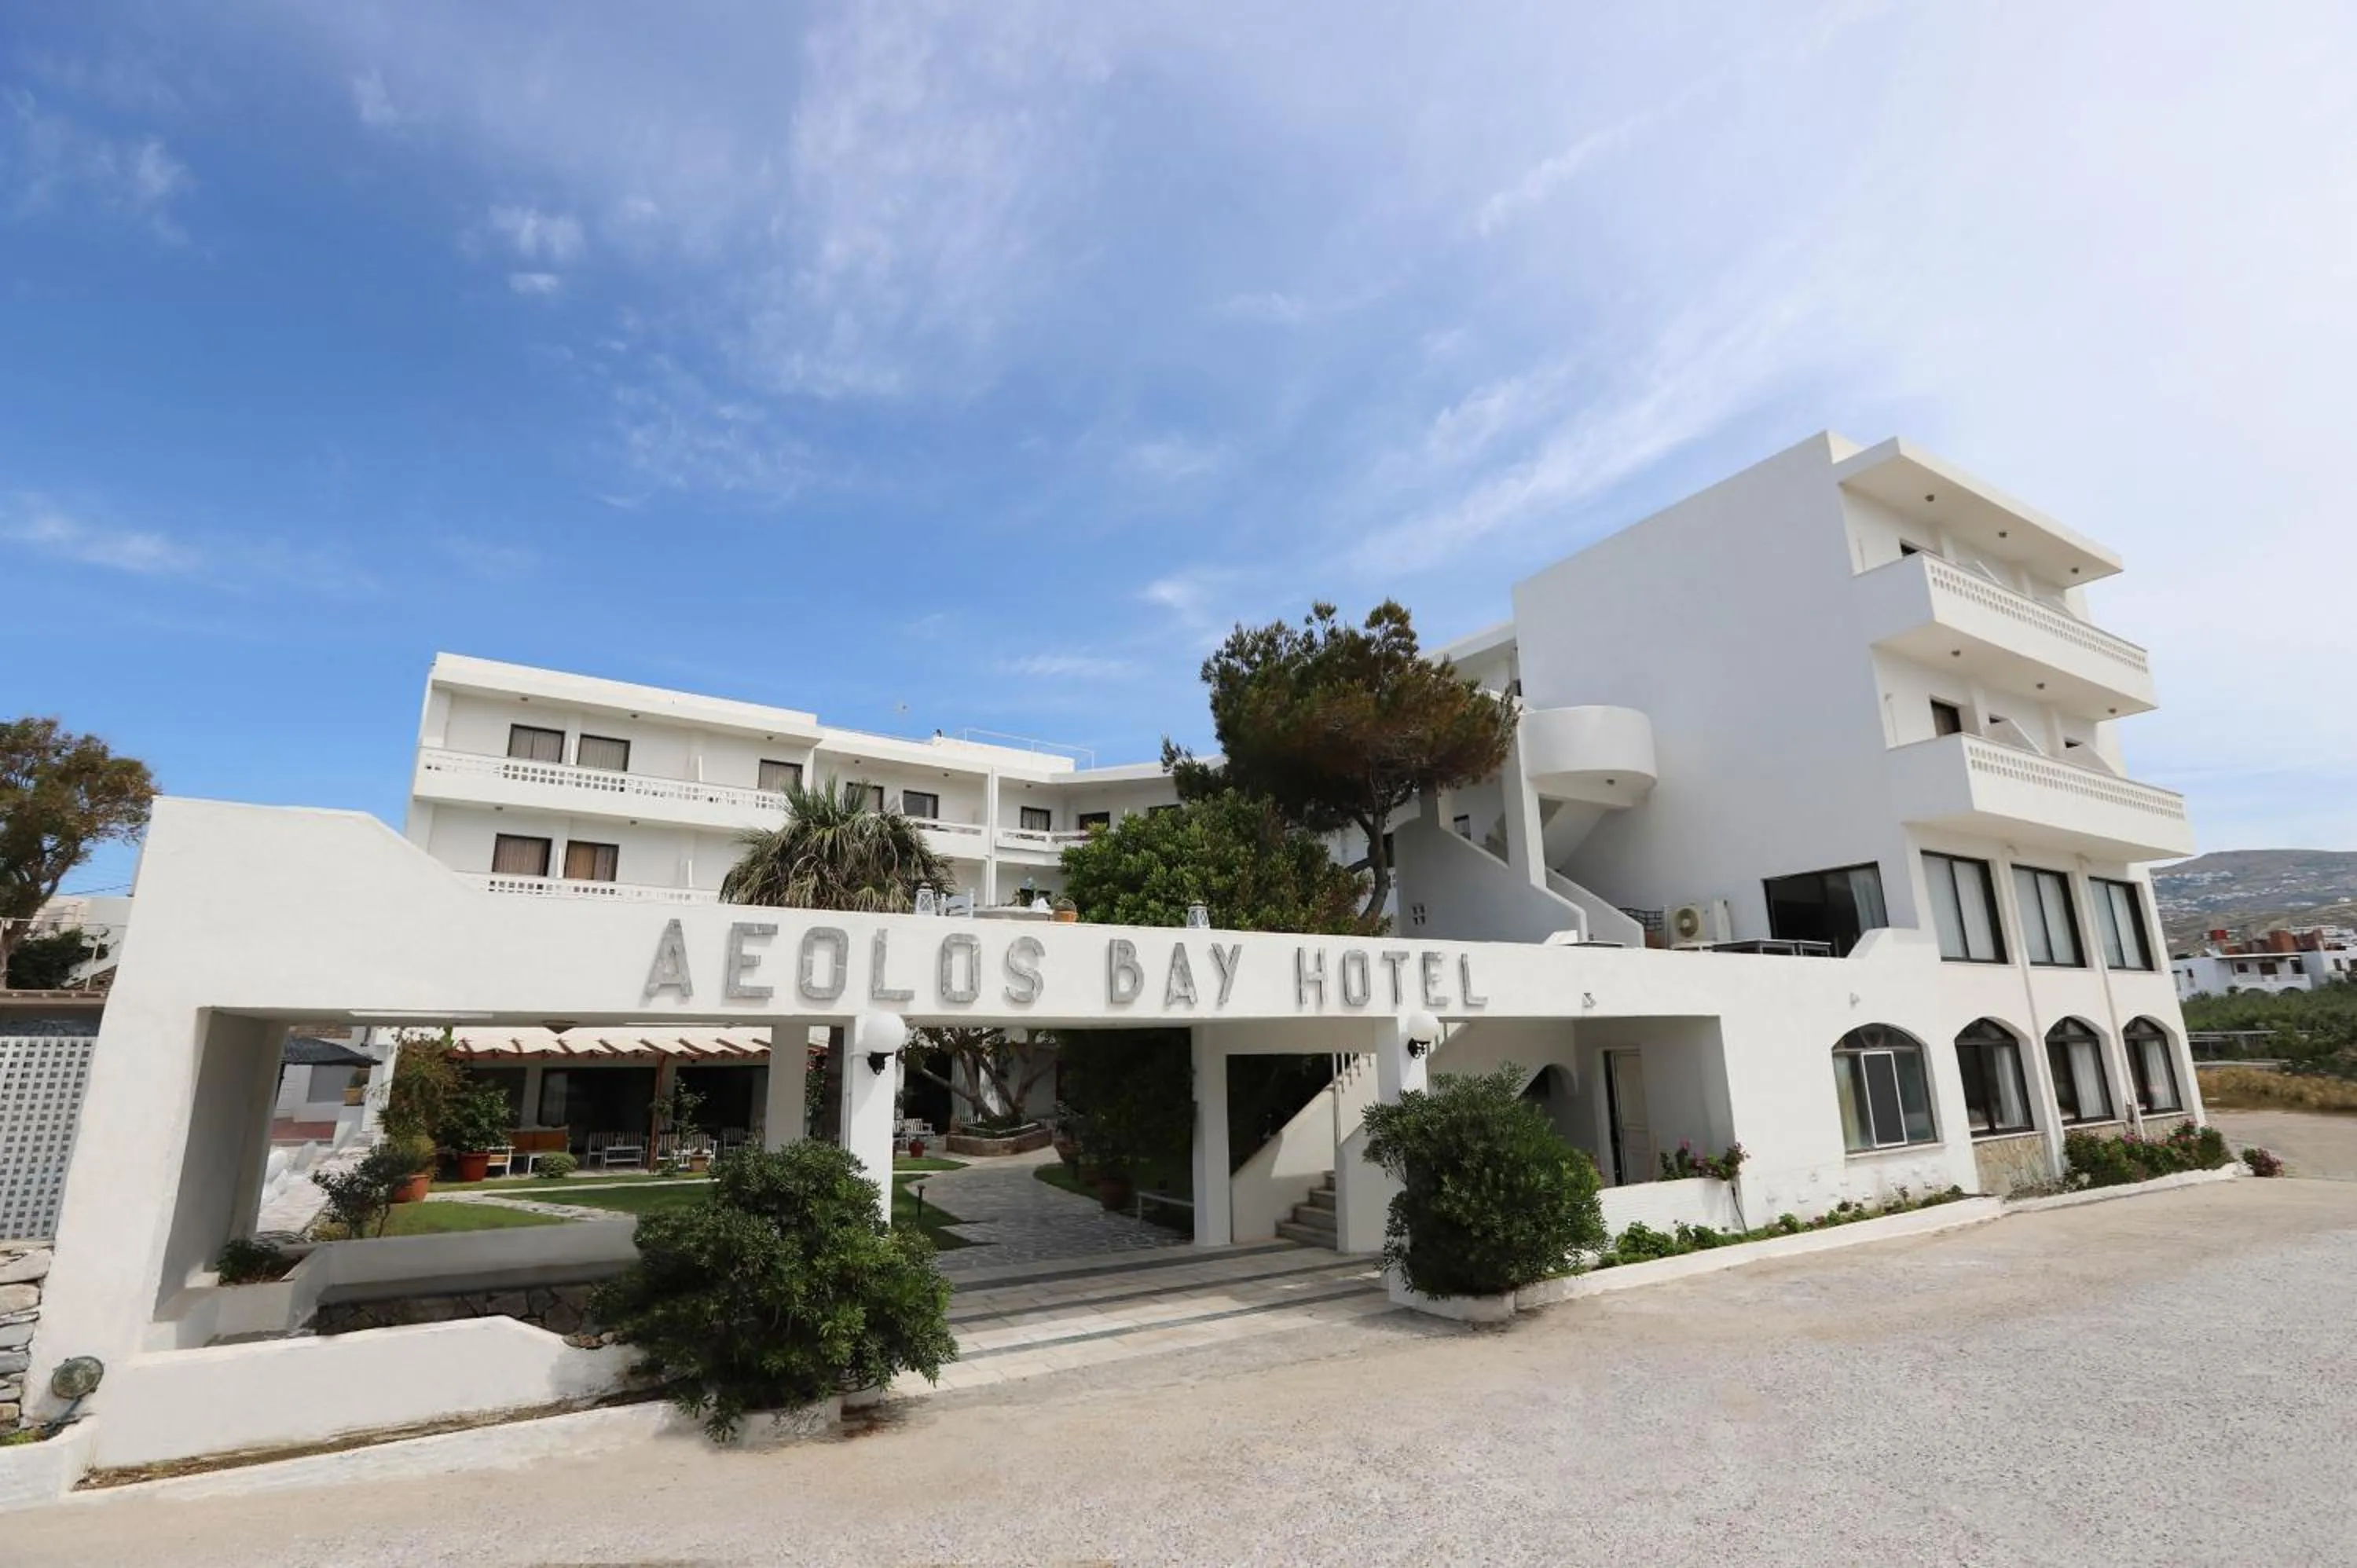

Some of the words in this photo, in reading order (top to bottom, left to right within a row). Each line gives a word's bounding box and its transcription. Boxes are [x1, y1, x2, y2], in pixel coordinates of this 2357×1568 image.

[644, 918, 1046, 1004] AEOLOS
[1108, 938, 1242, 1006] BAY
[1296, 946, 1489, 1007] HOTEL
